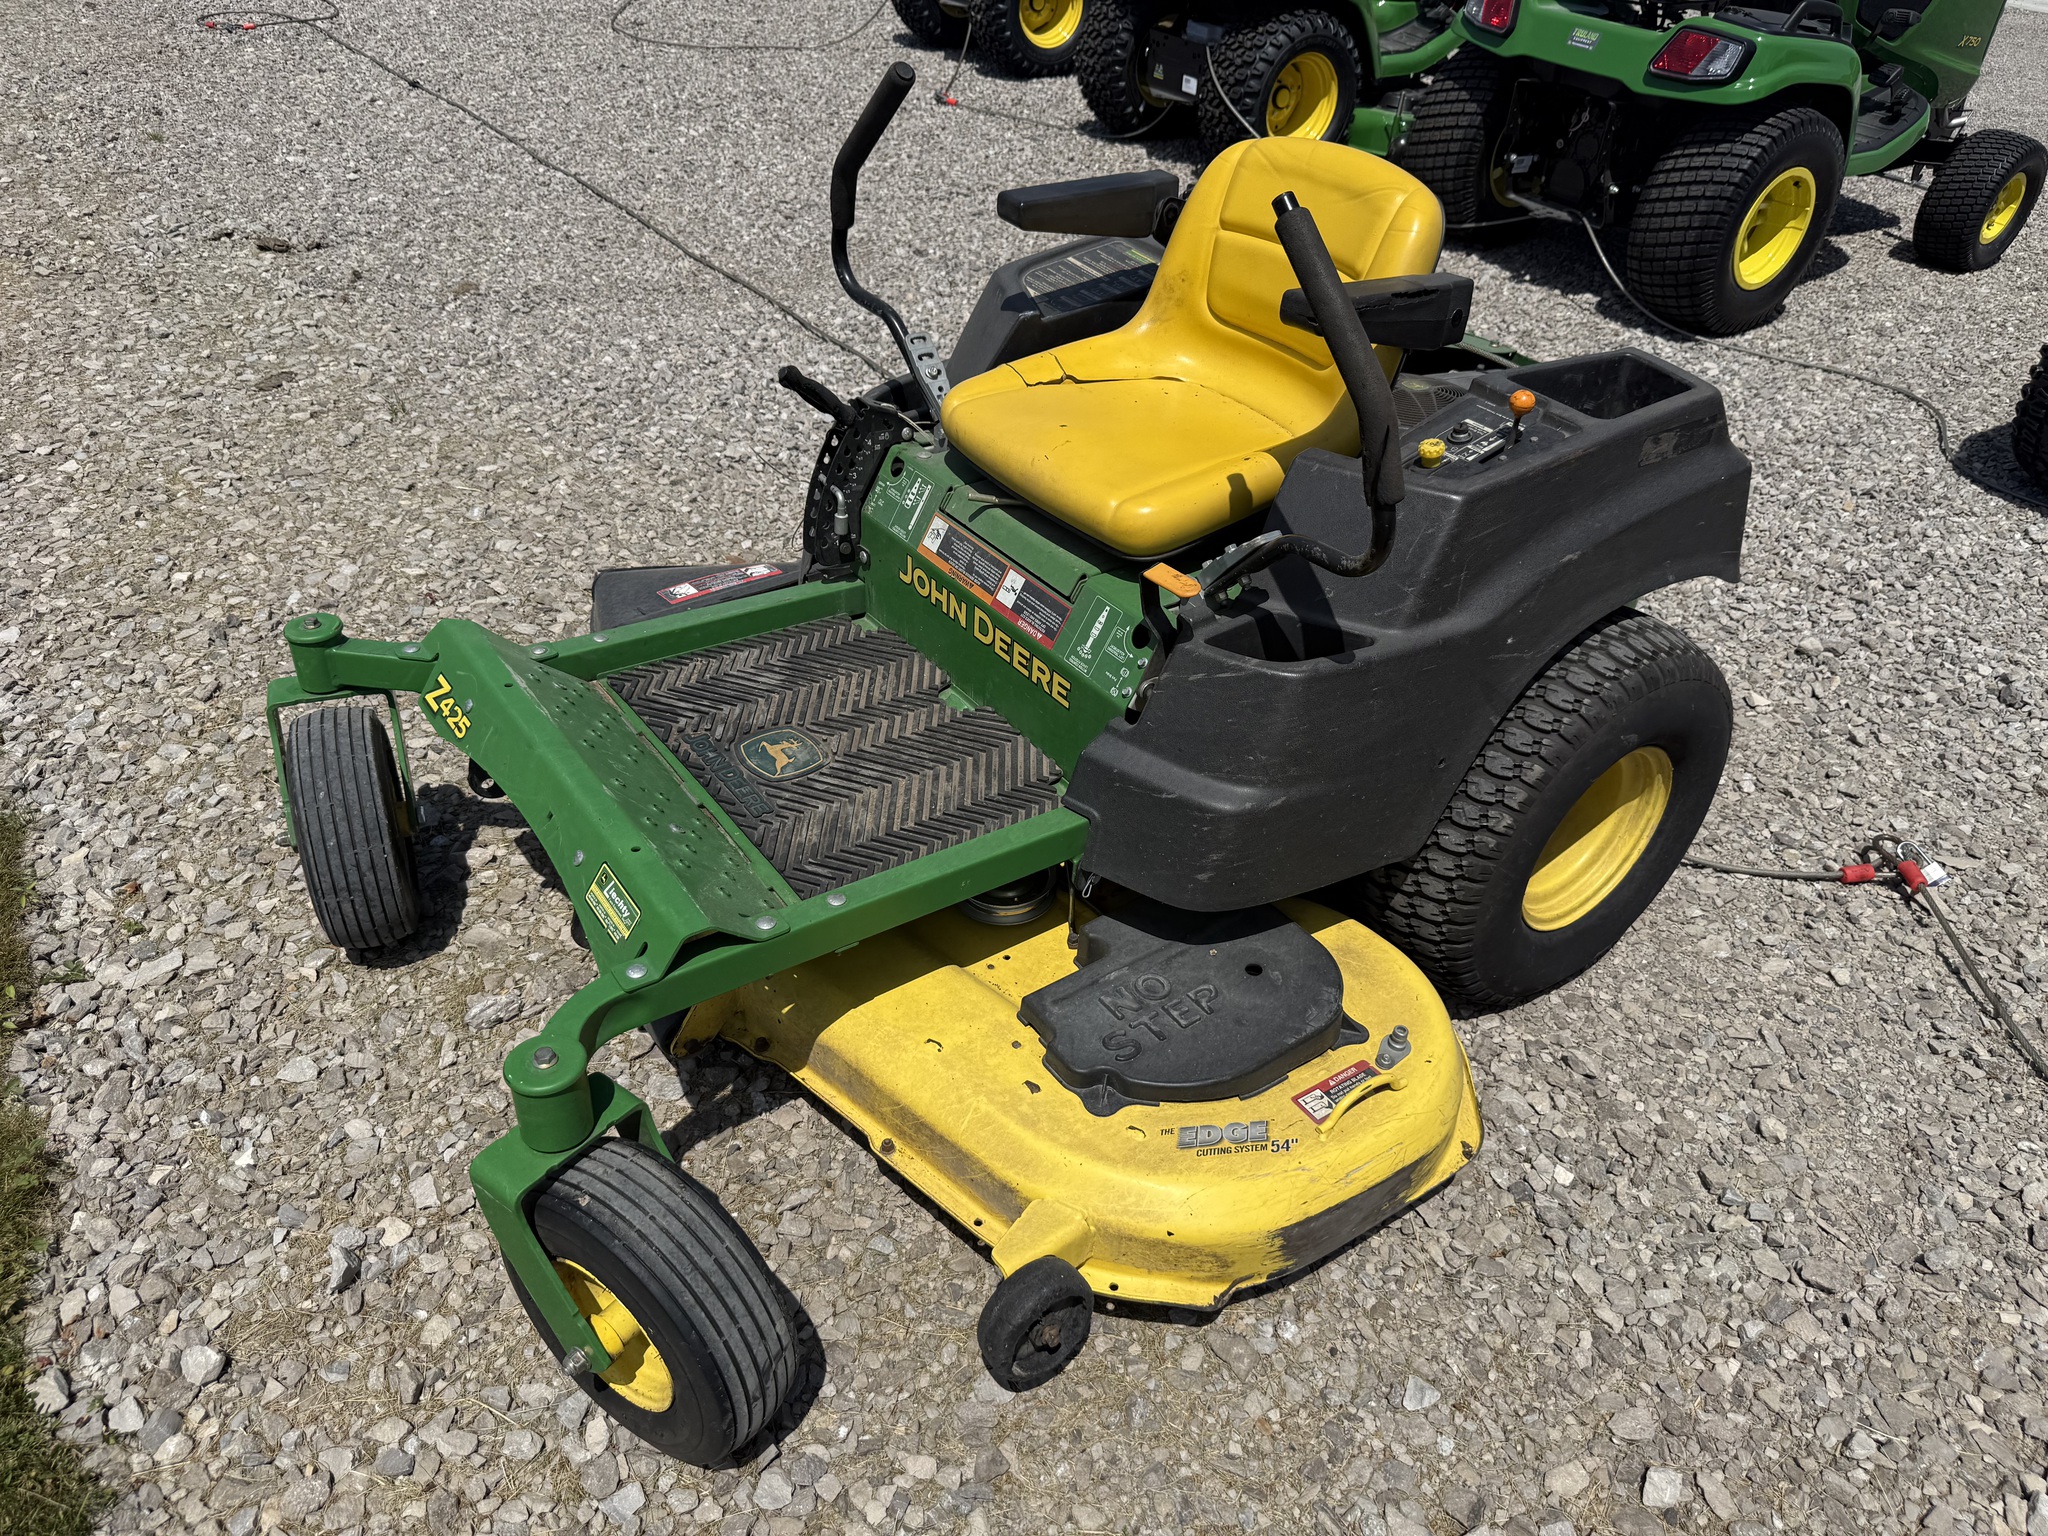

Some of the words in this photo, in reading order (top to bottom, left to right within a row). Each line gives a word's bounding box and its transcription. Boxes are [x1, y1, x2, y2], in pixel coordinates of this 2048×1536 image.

[1958, 34, 1982, 47] X750
[947, 567, 971, 588] WARNING
[899, 554, 967, 631] JOHN
[973, 605, 1072, 711] DEERE
[1016, 618, 1037, 637] DANGER
[424, 673, 472, 739] Z425
[684, 733, 731, 772] JOHN
[716, 766, 771, 815] DEERE
[603, 880, 630, 918] Liechty
[1099, 973, 1172, 1020] NO
[1102, 984, 1218, 1061] STEP
[1330, 1078, 1352, 1094] ROTATING
[1332, 1066, 1358, 1083] DANGER
[1160, 1128, 1176, 1136] THE
[1177, 1120, 1268, 1149] EDGE
[1196, 1146, 1232, 1157] CUTTING
[1234, 1143, 1268, 1154] SYSTEM
[1270, 1138, 1298, 1153] 54"
